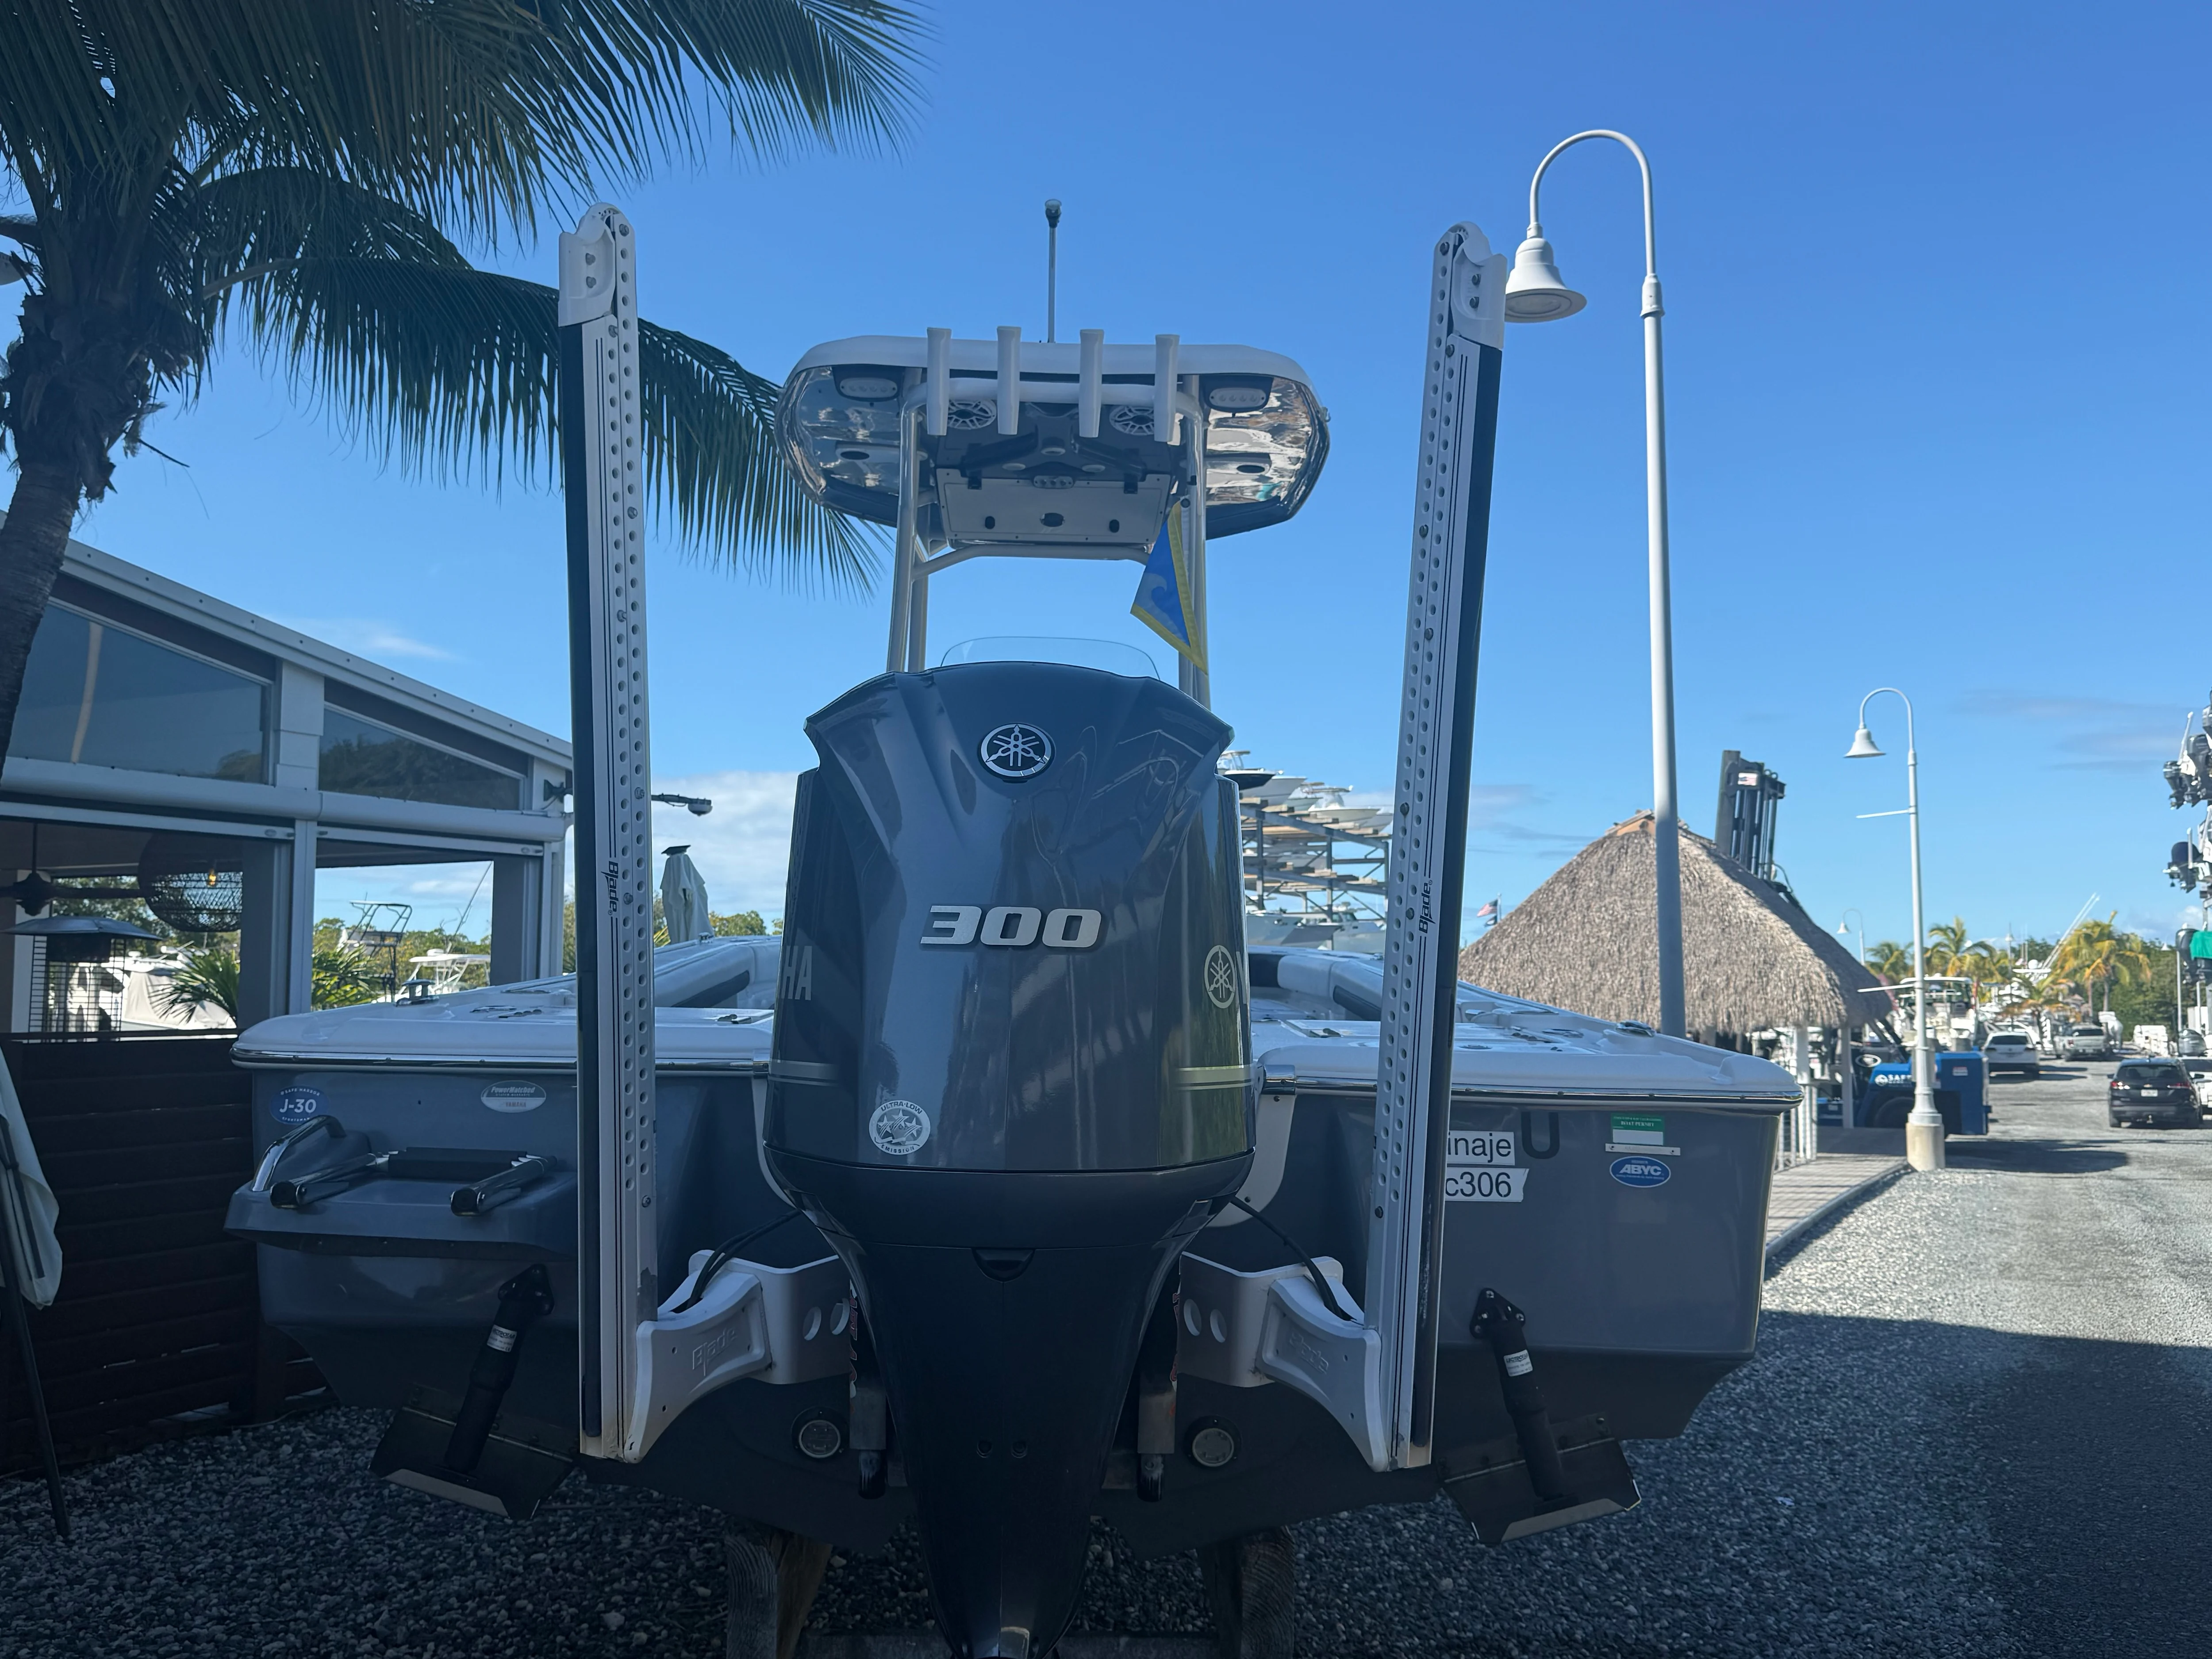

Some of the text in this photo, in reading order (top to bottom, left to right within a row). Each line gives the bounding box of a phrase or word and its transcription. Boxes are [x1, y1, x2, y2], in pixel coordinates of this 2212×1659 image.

[600, 860, 619, 912] Blade
[1419, 883, 1436, 934] Blade
[920, 905, 1102, 948] 300
[279, 1098, 317, 1113] J-30
[881, 1144, 915, 1153] EMISSION
[1619, 1164, 1662, 1175] ABYC
[1445, 1171, 1511, 1198] c306
